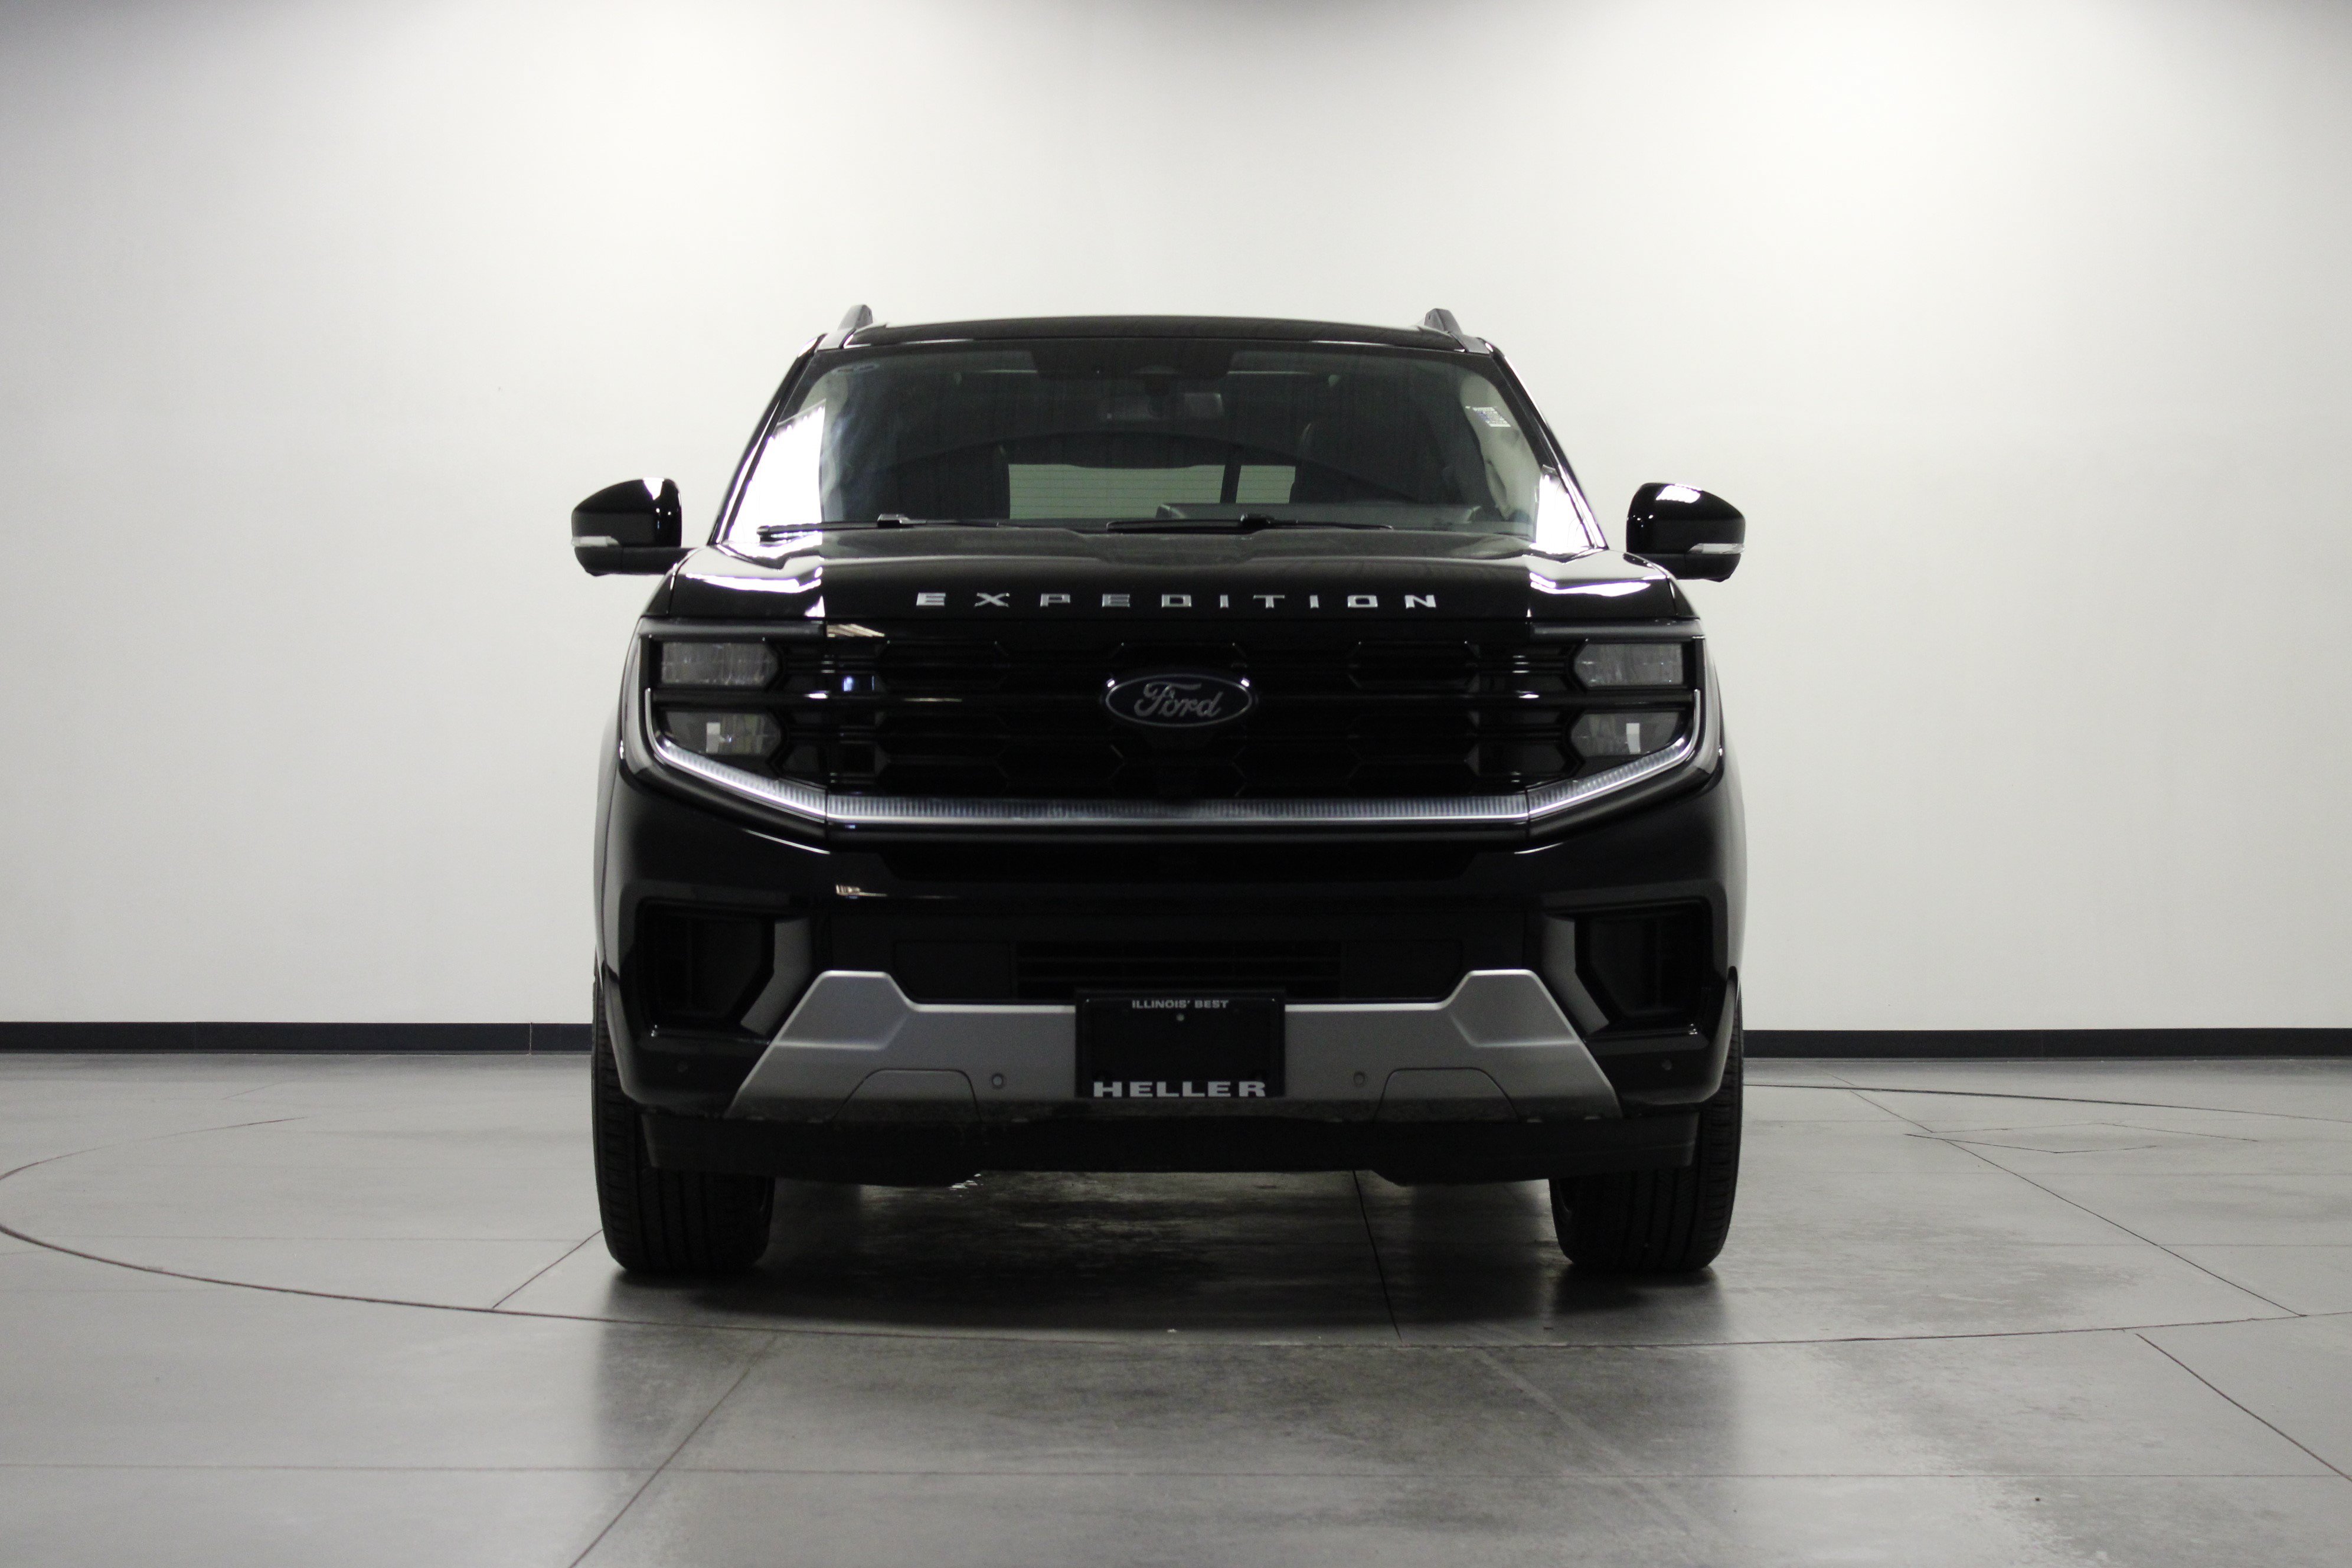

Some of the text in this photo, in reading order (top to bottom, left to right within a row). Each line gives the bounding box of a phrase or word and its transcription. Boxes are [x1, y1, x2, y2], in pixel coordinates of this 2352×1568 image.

[916, 592, 1437, 609] EXPEDITION
[1133, 681, 1223, 718] Ford
[1194, 999, 1229, 1009] BEST
[1093, 1081, 1266, 1097] HELLER
